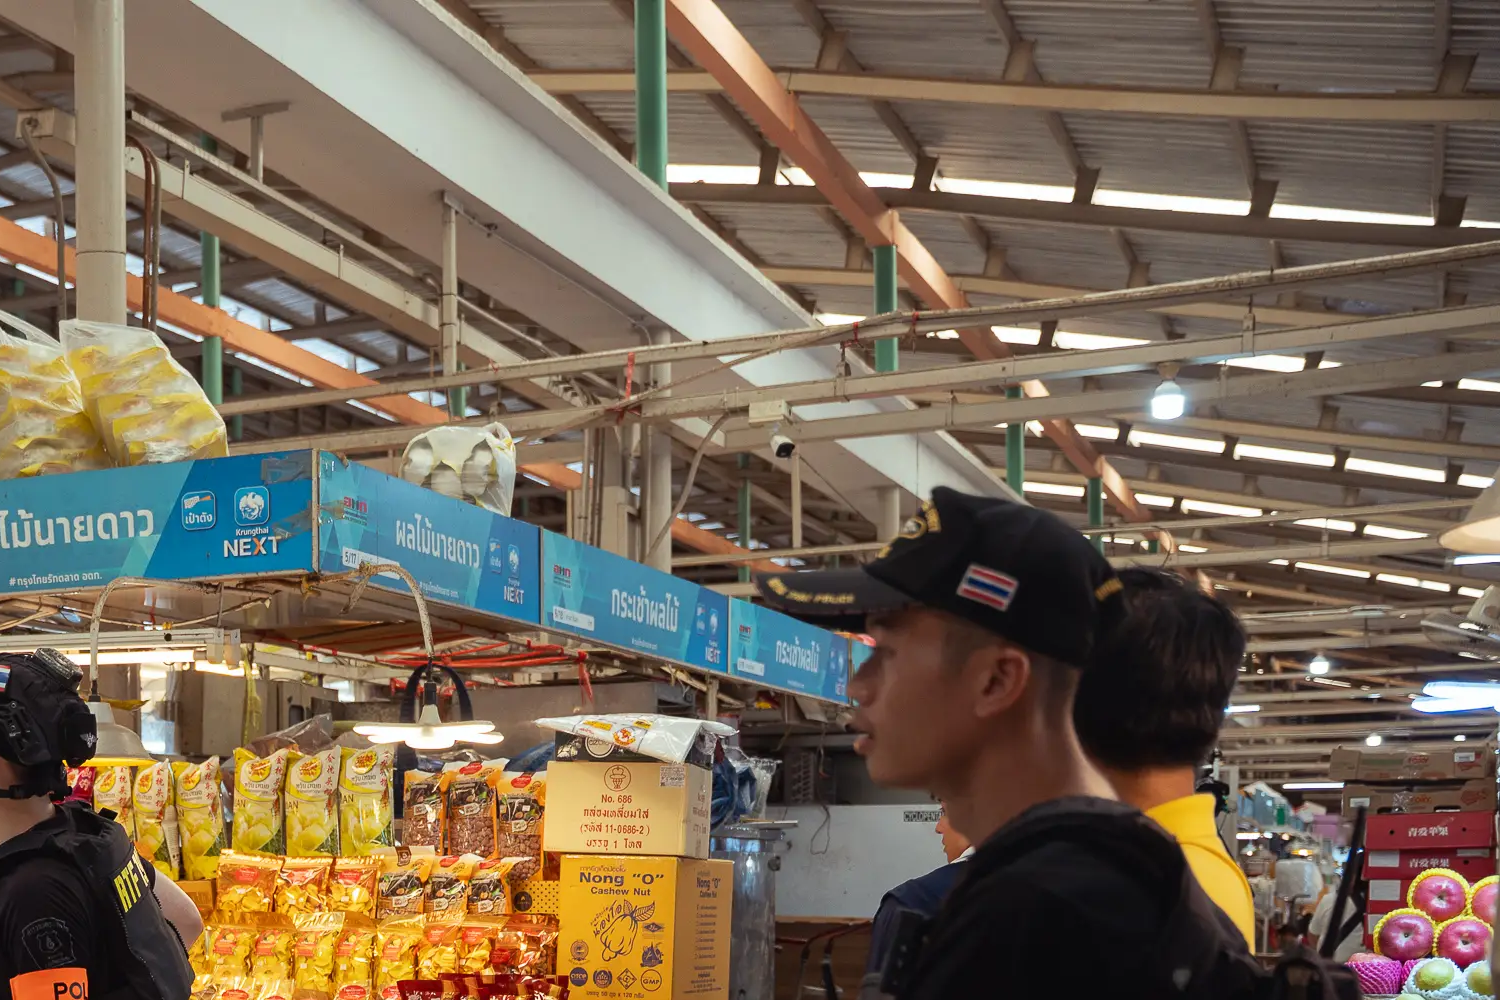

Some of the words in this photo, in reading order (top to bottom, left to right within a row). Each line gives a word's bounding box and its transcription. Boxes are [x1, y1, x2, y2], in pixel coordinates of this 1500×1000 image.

[235, 526, 270, 537] Krungthai
[223, 535, 281, 558] NEXT
[395, 513, 480, 568] ผลไม้นายดาว
[503, 586, 525, 605] NEXT
[611, 585, 680, 633] กระเช้าผลไม้
[775, 636, 820, 673] กระเช้าผลไม้
[601, 794, 615, 804] No.
[617, 794, 632, 804] 686
[605, 824, 644, 835] 11-0686-2
[586, 839, 609, 851] บรรจุ
[613, 840, 617, 849] 1
[623, 838, 643, 849] โหล
[579, 872, 625, 887] Nong
[696, 876, 711, 891] Nong
[590, 887, 629, 896] Cashew
[633, 888, 651, 896] Nut
[642, 977, 660, 985] GMP
